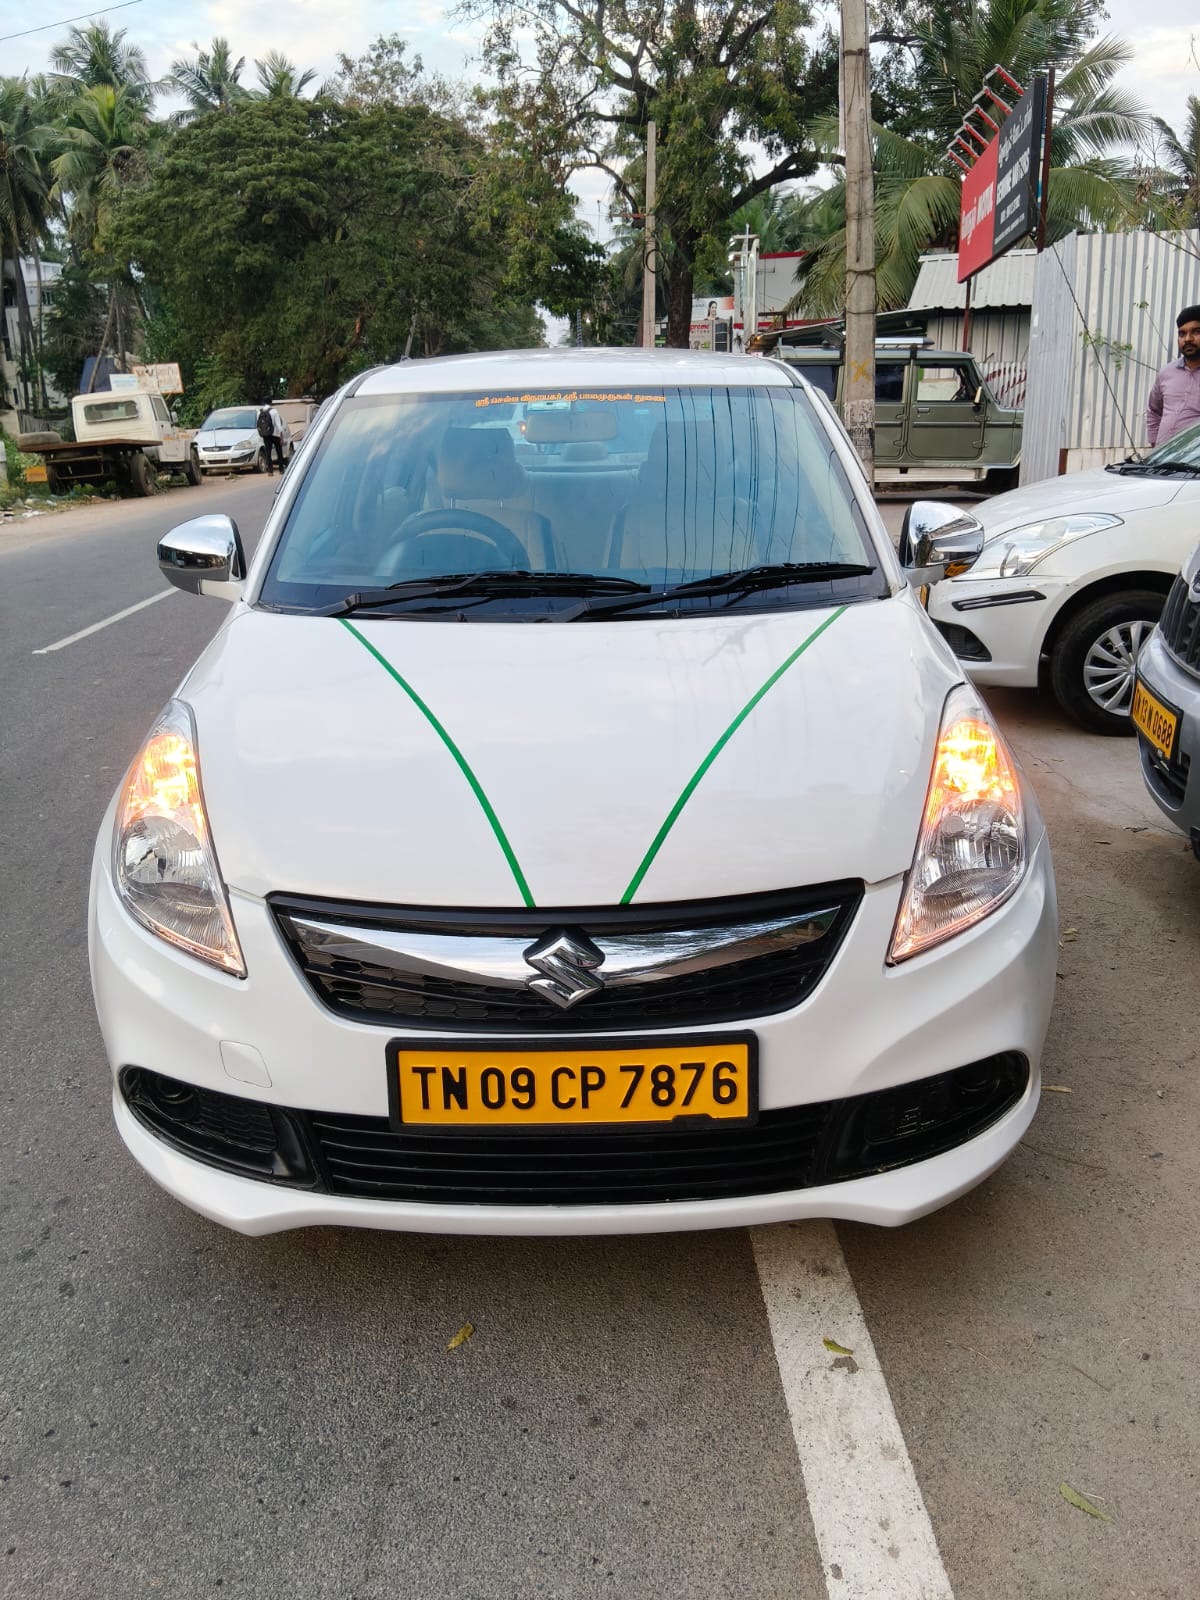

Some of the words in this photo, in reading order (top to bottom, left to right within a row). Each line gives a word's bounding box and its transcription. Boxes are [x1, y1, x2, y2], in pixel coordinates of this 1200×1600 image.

[1152, 710, 1172, 749] 0688
[412, 1066, 469, 1110] TN
[480, 1066, 536, 1110] 09
[551, 1066, 606, 1110] CP
[619, 1061, 738, 1109] 7876
